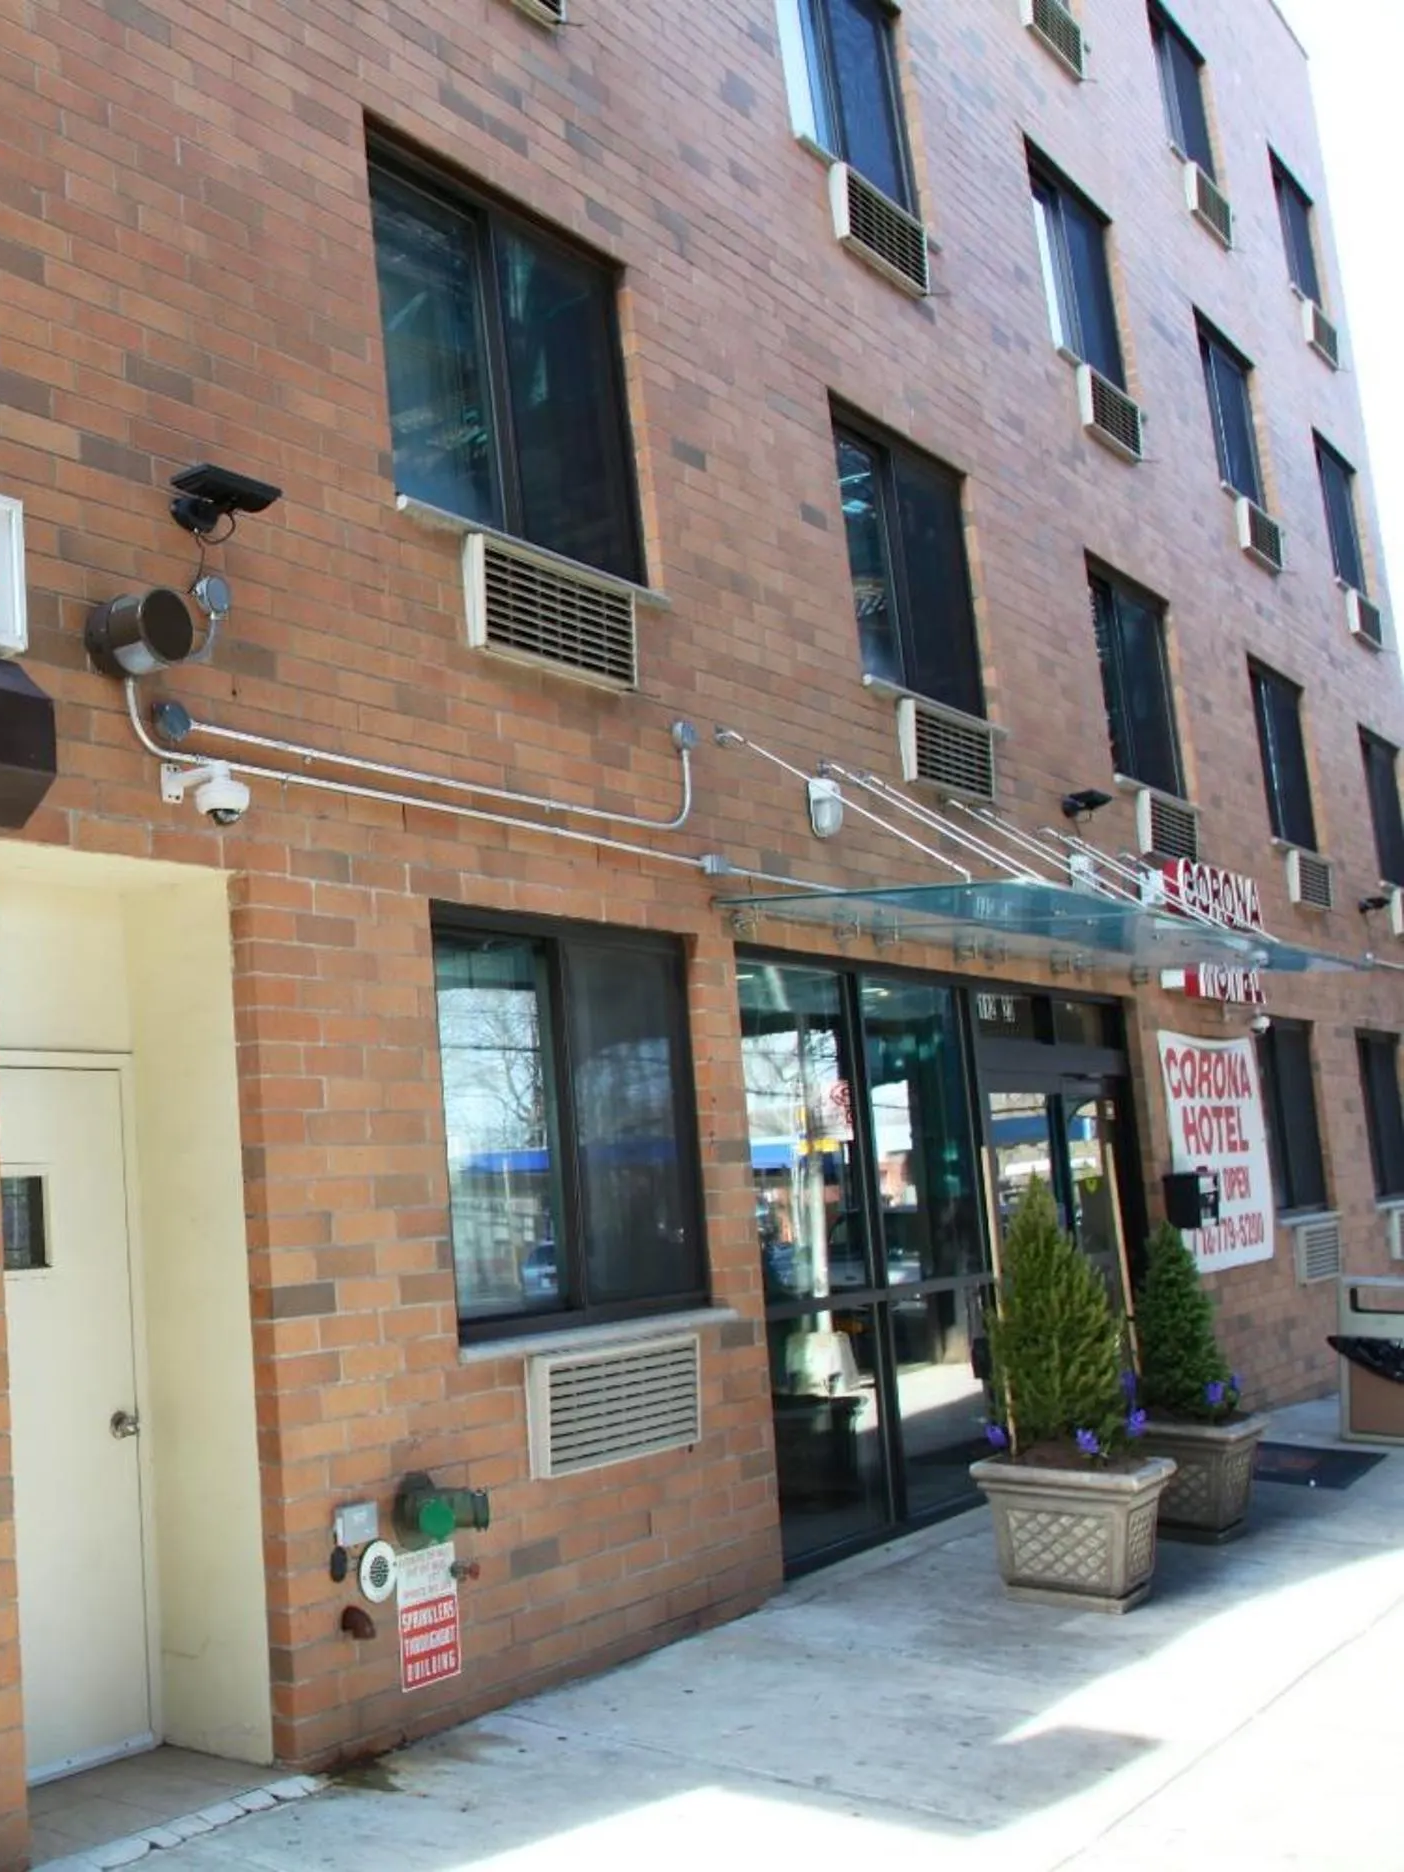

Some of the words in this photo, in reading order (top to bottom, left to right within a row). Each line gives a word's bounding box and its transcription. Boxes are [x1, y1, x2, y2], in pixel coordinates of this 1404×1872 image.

[1178, 857, 1264, 931] CORONA
[1199, 962, 1267, 1004] HOTEL
[1165, 1048, 1252, 1100] CORONA
[1182, 1105, 1249, 1155] HOTEL
[1223, 1166, 1251, 1202] OPEN
[401, 1599, 455, 1633] SPRINKLERS
[407, 1649, 456, 1683] BUILDING
